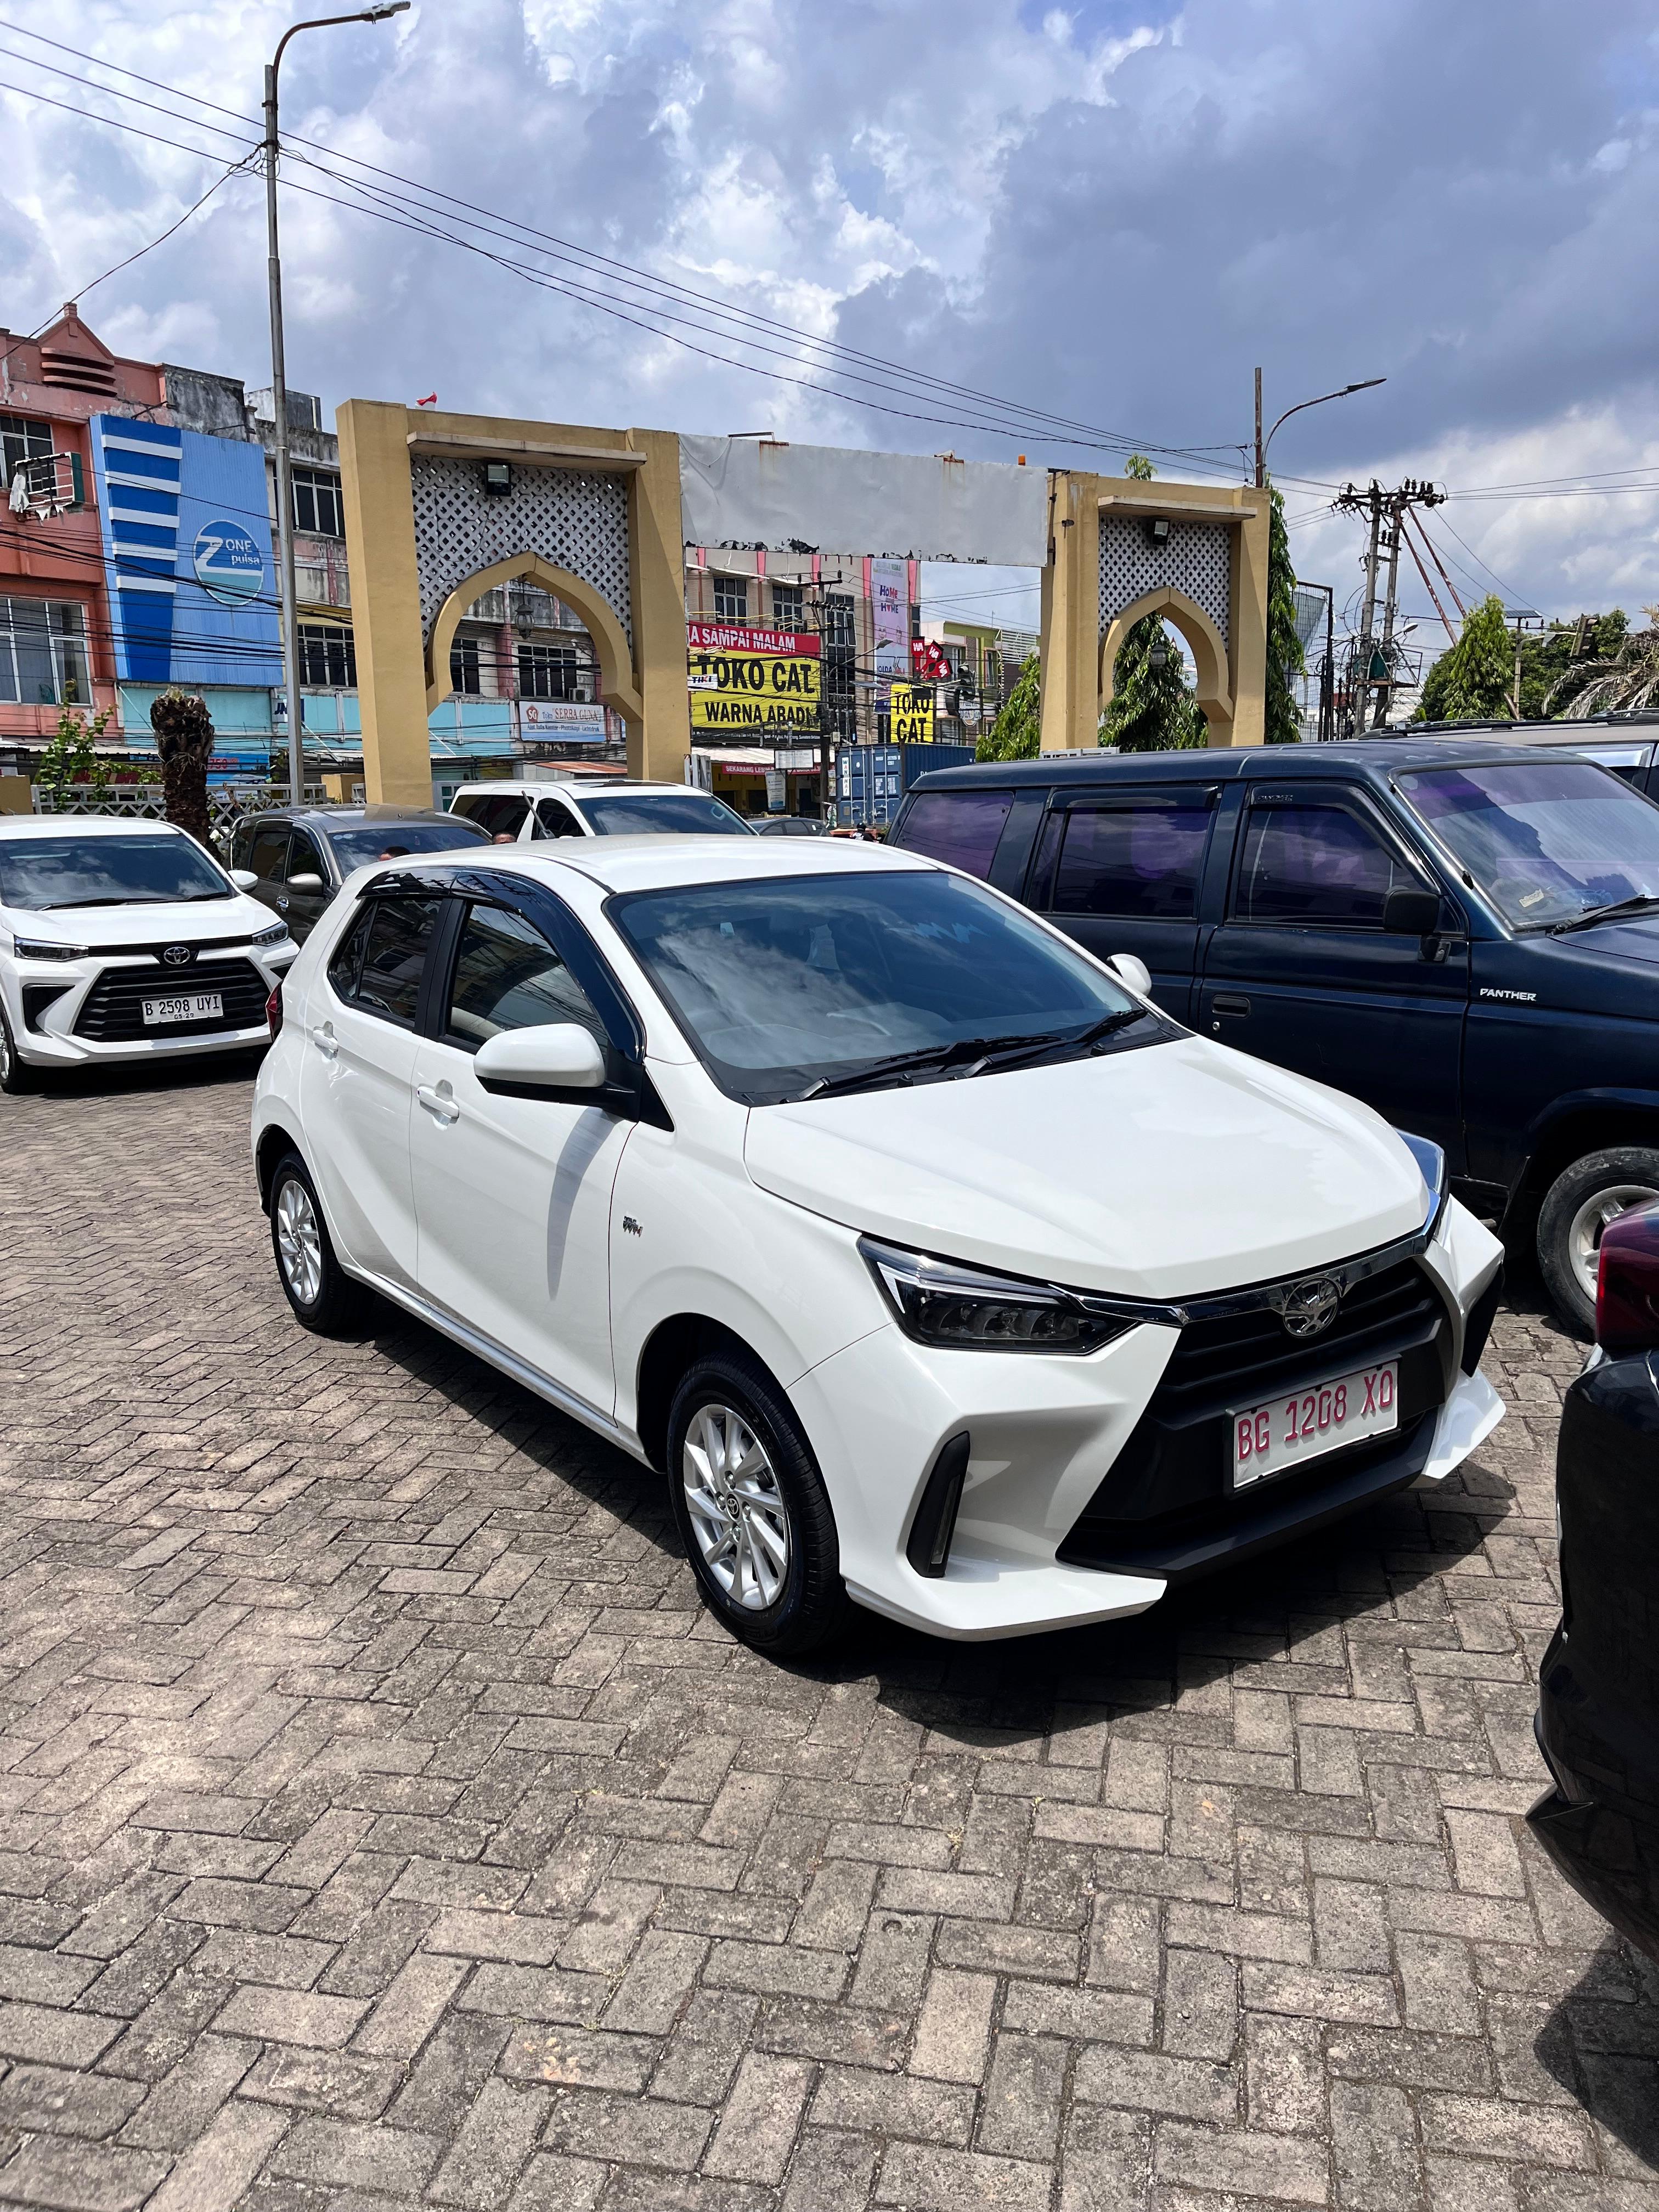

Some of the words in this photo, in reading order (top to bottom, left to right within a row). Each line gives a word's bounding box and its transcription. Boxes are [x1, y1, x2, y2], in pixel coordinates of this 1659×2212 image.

[231, 553, 259, 566] pulsa
[702, 628, 750, 648] SAMPAI
[753, 632, 795, 652] MALAM
[913, 642, 924, 651] WA
[929, 646, 939, 659] WA
[697, 655, 764, 691] TOKO
[772, 662, 815, 693] CAT
[938, 662, 948, 678] WA
[528, 709, 537, 720] SG
[704, 702, 764, 724] WARNA
[897, 718, 927, 743] CAT
[1480, 988, 1537, 1001] PANTHER
[145, 1002, 154, 1016] B
[159, 999, 190, 1014] 2598
[196, 996, 220, 1011] UYI
[1238, 1410, 1269, 1460] BG
[1284, 1384, 1347, 1442] 1208
[1362, 1370, 1393, 1414] XO
